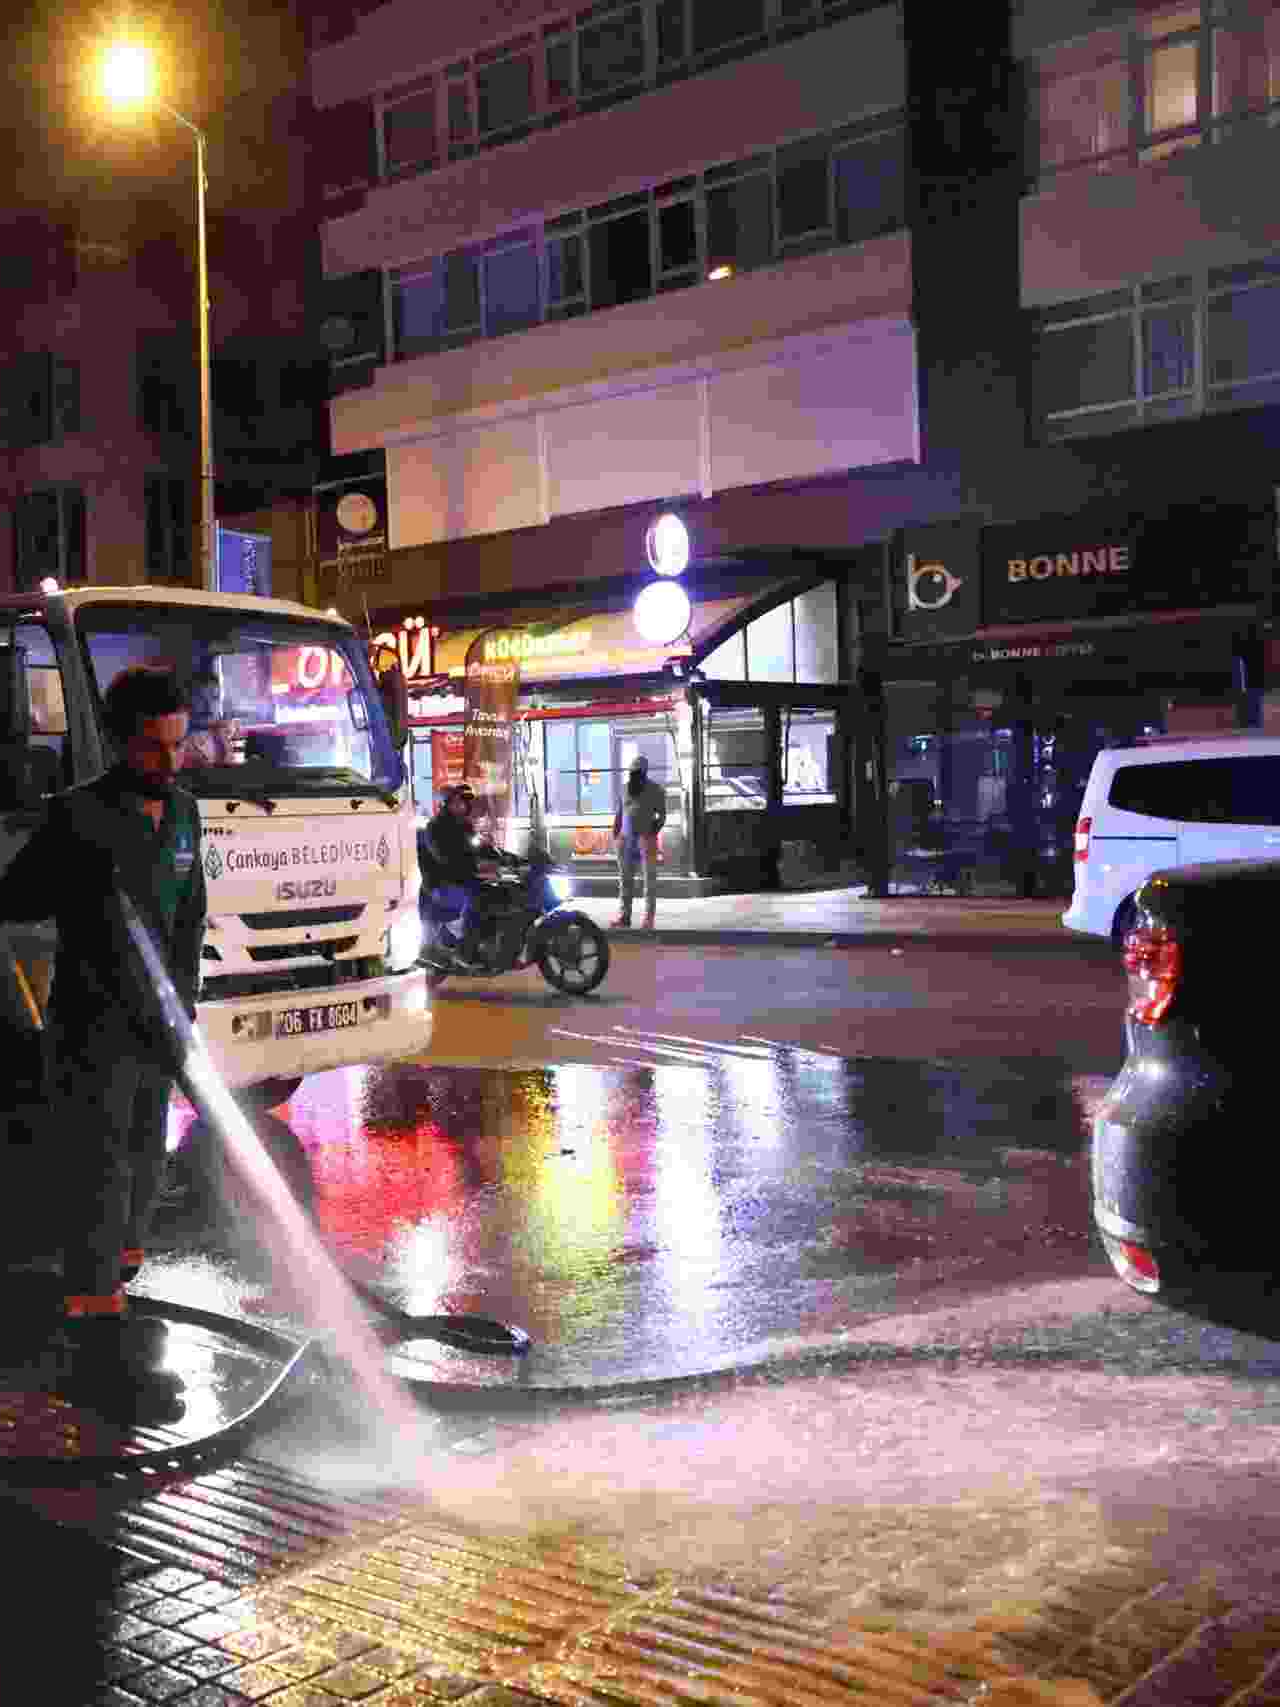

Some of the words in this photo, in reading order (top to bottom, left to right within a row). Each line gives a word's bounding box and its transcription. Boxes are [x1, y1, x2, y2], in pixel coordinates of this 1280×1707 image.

[1007, 545, 1130, 584] BONNE
[226, 847, 289, 873] Çankaya
[276, 878, 337, 901] ISUZU
